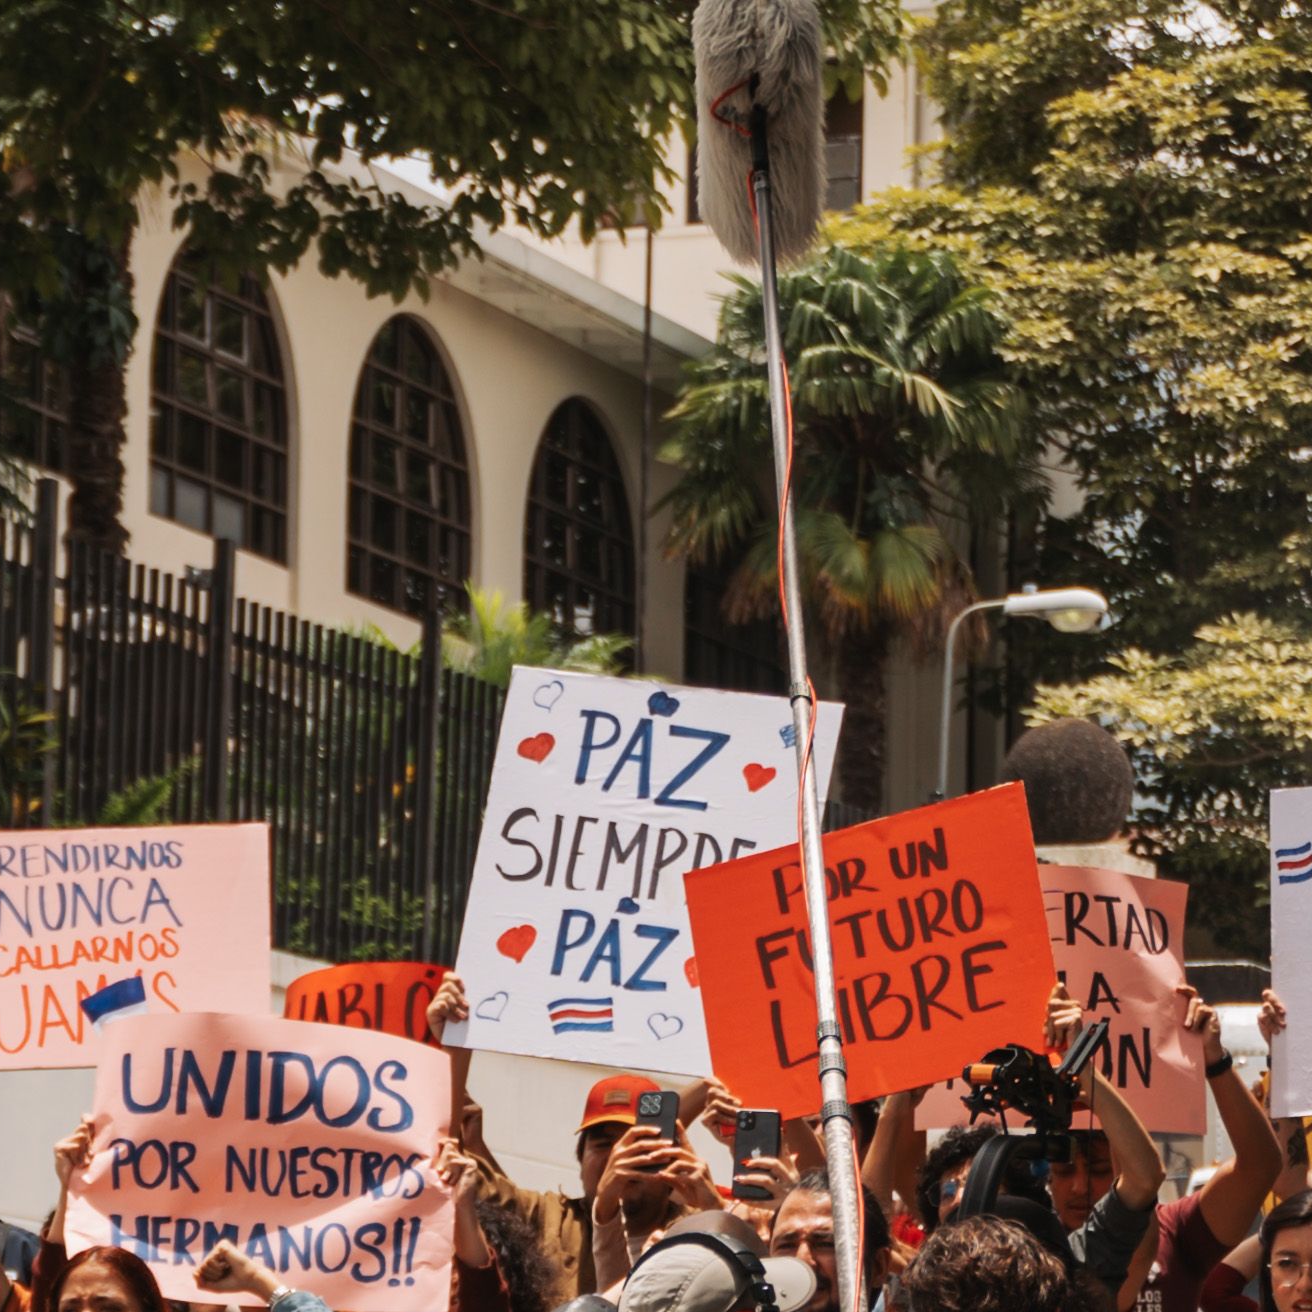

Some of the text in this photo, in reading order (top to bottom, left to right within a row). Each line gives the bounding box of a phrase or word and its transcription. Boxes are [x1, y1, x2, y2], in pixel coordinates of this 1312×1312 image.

[889, 827, 948, 879] UN
[121, 1047, 414, 1133] UNIDOS
[110, 1138, 425, 1200] POR NUESTROS
